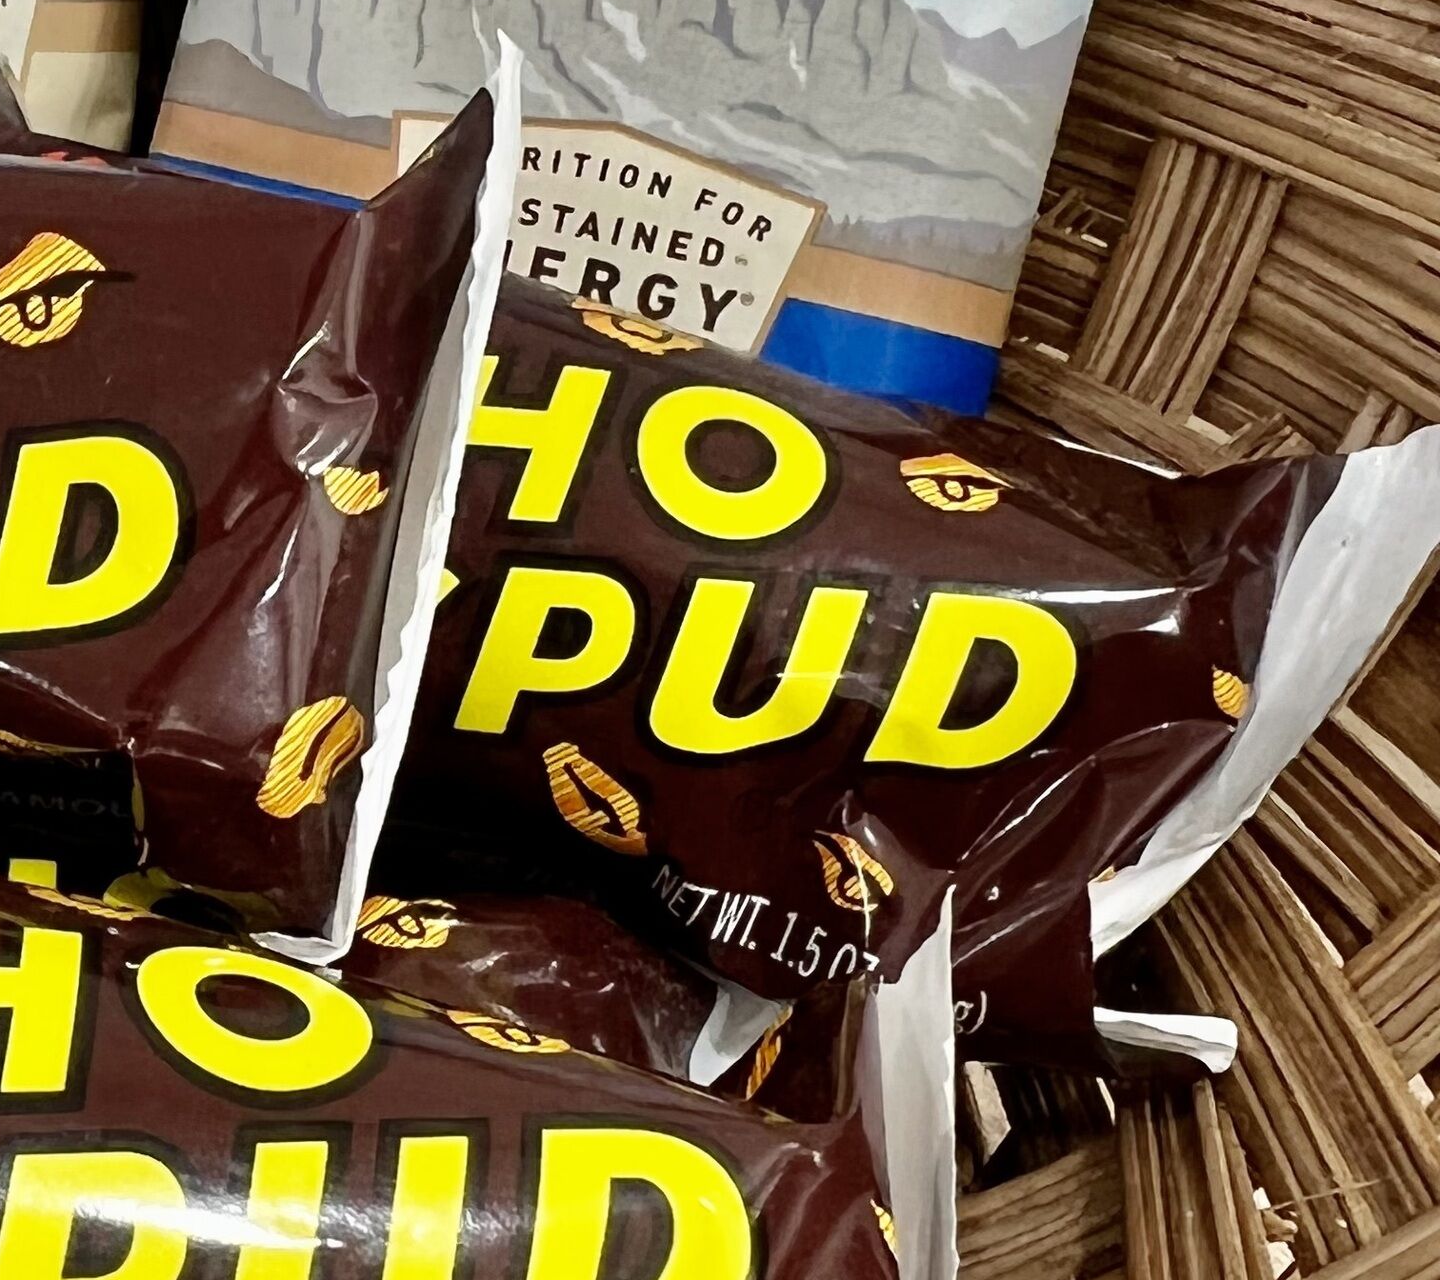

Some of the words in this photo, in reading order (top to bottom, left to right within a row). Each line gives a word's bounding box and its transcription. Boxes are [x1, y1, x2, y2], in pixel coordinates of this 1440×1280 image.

[517, 197, 726, 268] STAINED
[520, 146, 673, 199] RITION
[693, 187, 772, 243] FOR
[505, 239, 738, 333] ERGY
[436, 569, 1077, 769] PUD
[650, 863, 720, 927] NET
[711, 891, 772, 951] WT.
[769, 911, 828, 978] 1.5
